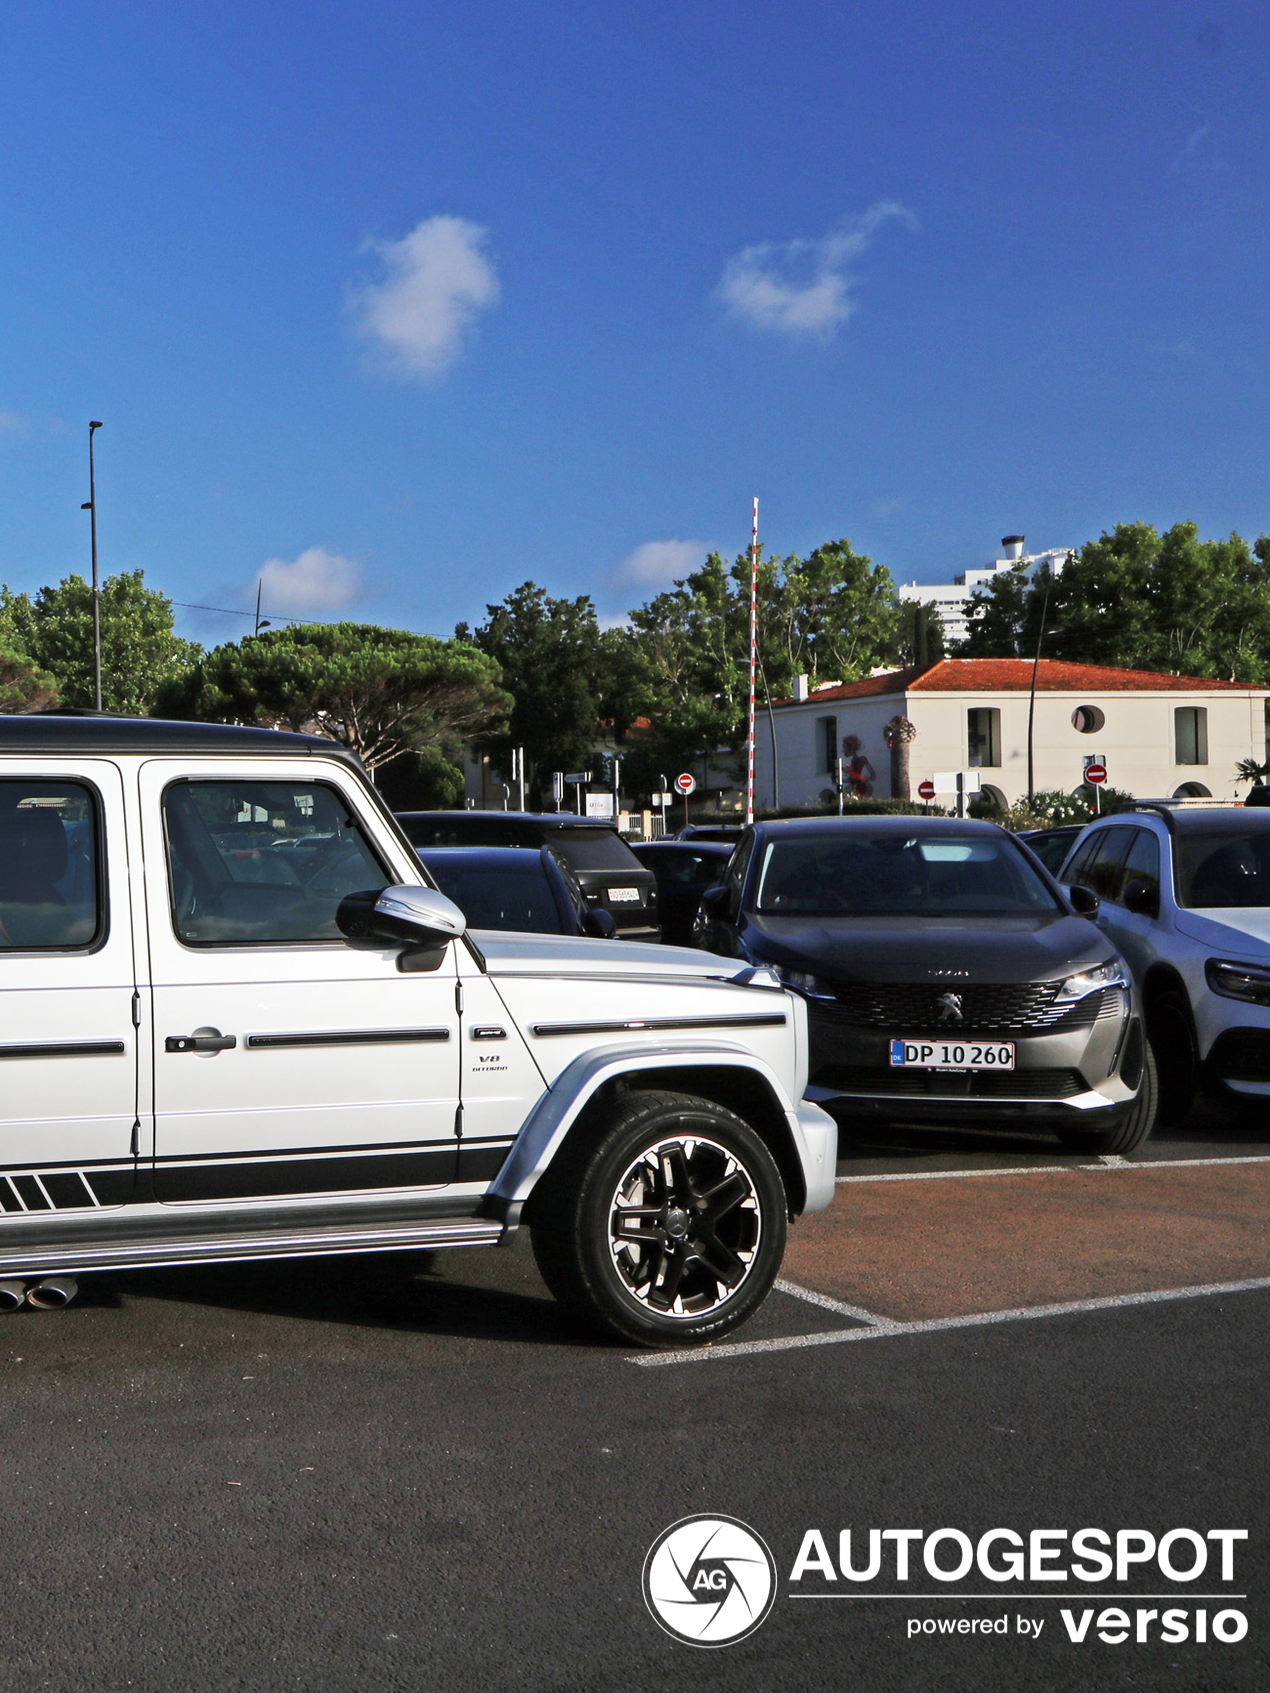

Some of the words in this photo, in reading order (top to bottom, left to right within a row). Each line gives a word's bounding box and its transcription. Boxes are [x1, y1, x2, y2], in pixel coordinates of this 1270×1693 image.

[479, 1055, 500, 1063] V8
[905, 1045, 934, 1063] DP
[941, 1046, 965, 1064] 10
[970, 1046, 1011, 1065] 260
